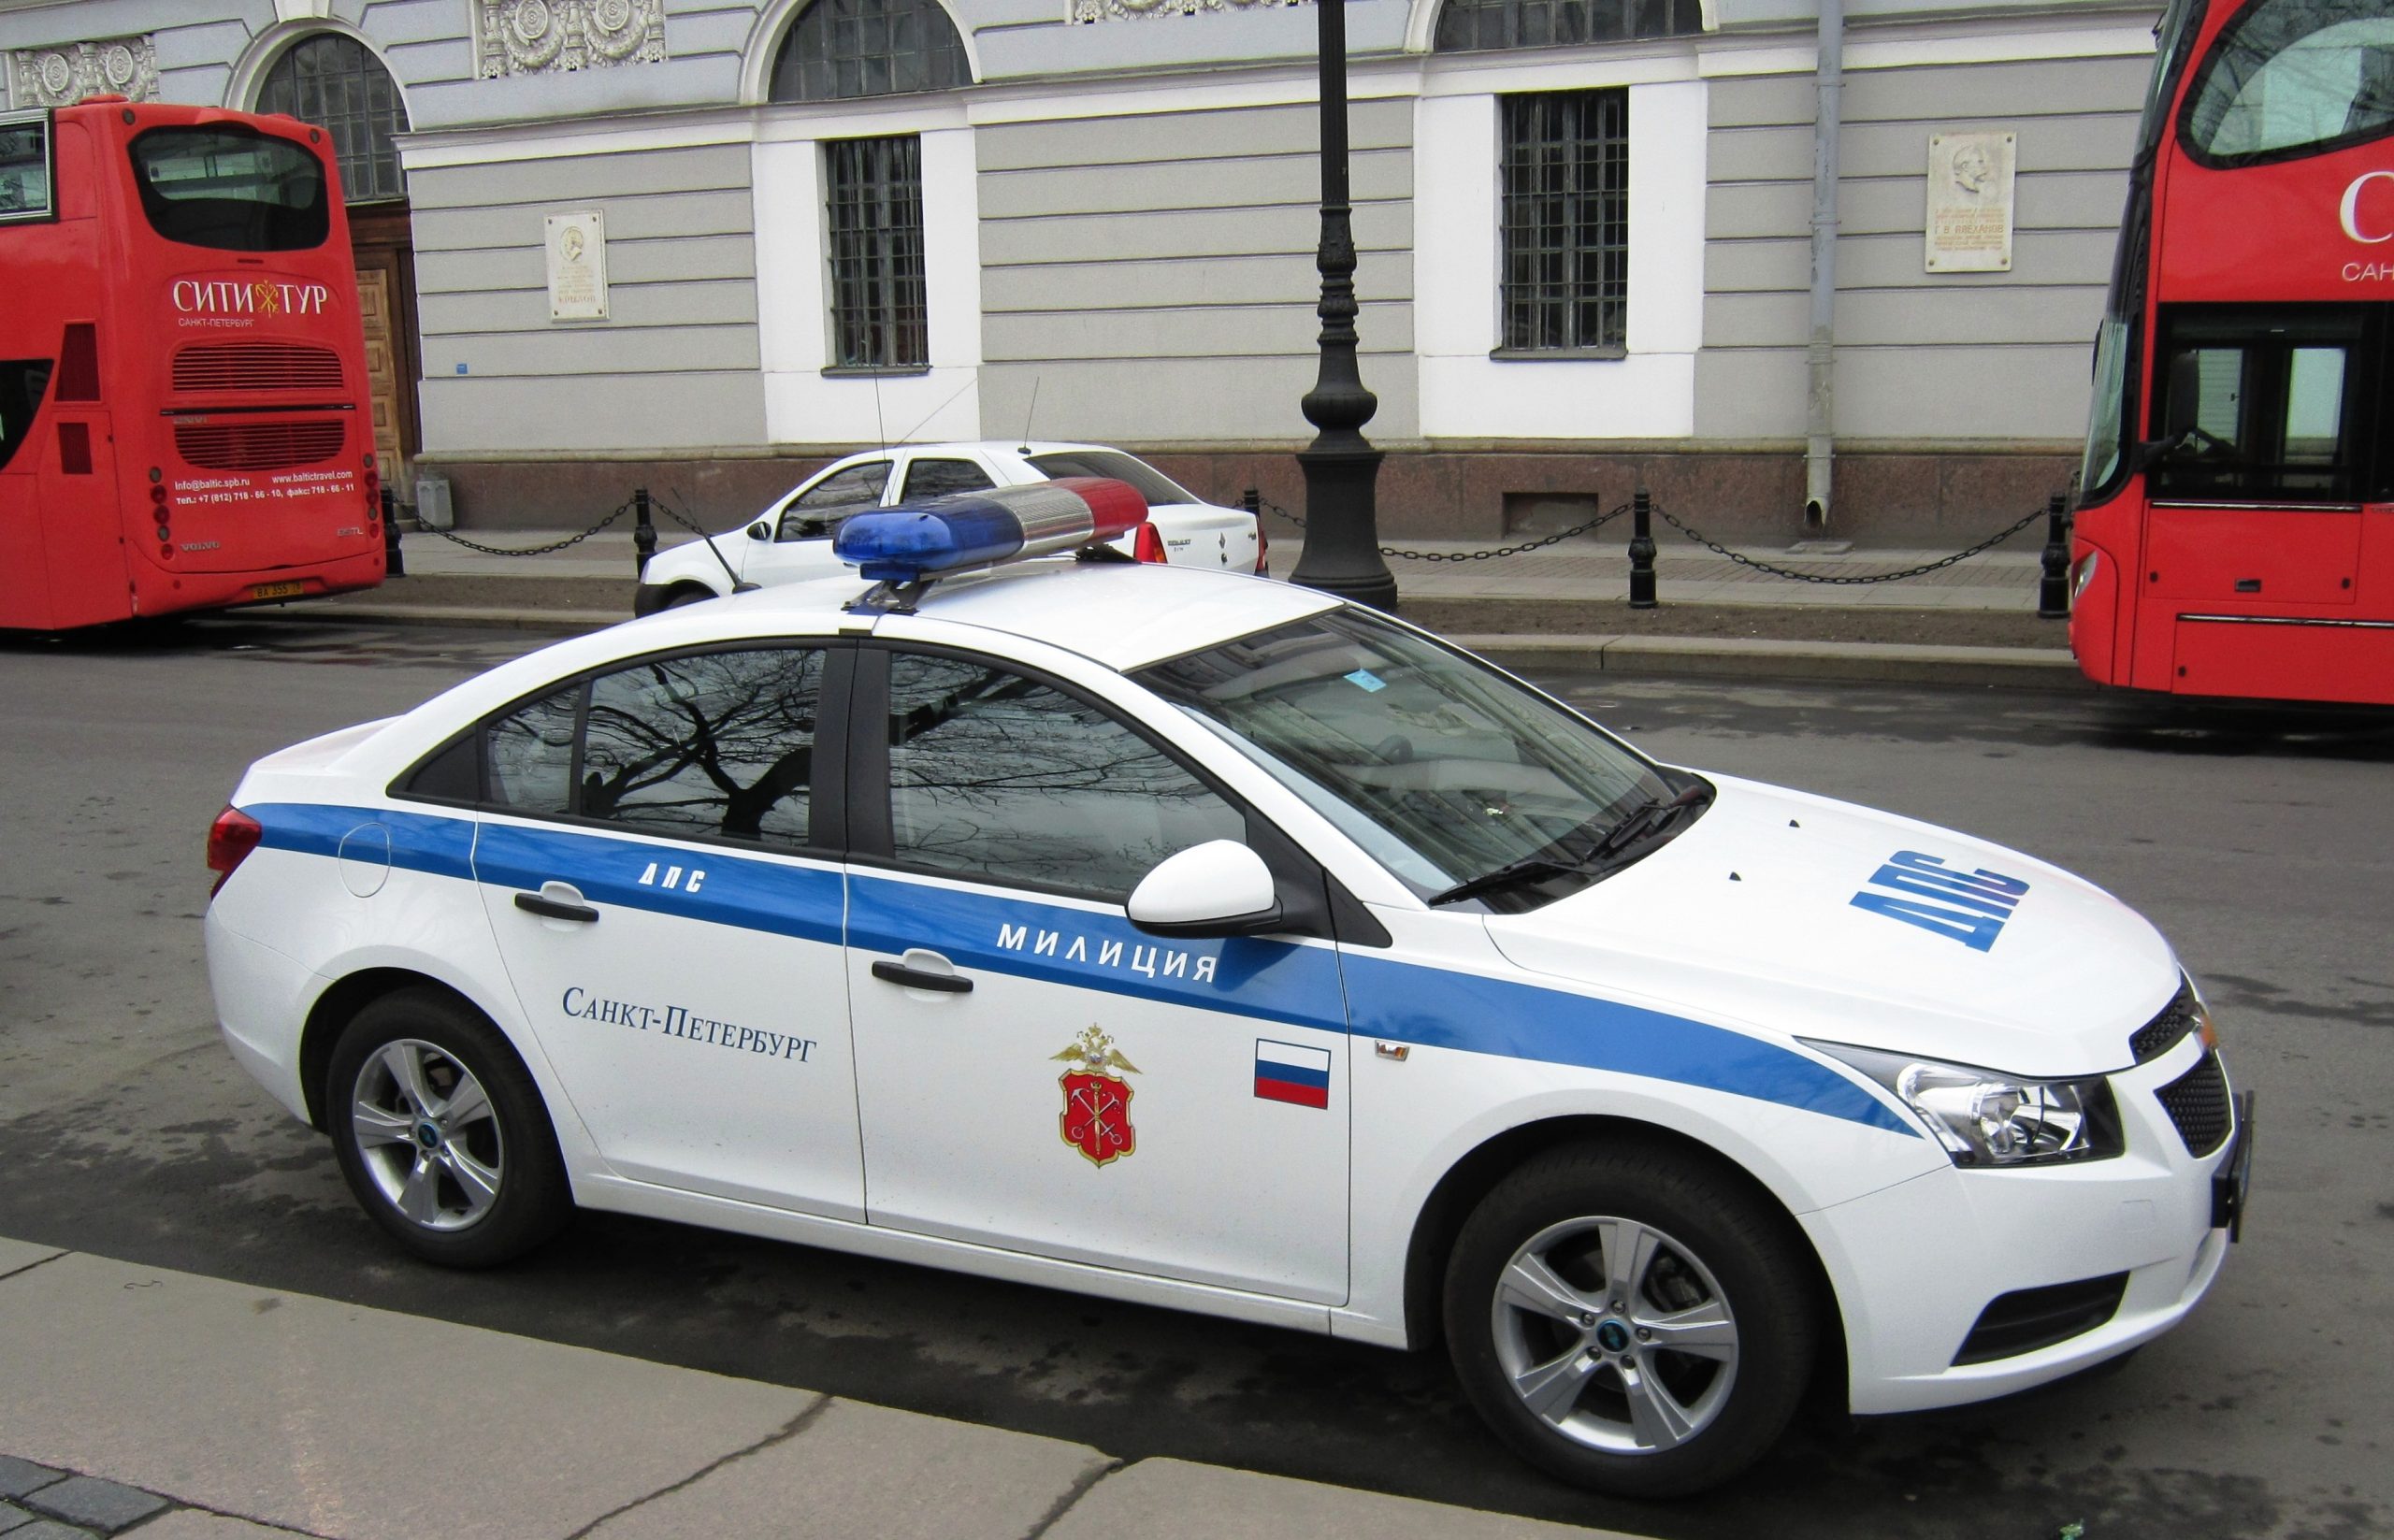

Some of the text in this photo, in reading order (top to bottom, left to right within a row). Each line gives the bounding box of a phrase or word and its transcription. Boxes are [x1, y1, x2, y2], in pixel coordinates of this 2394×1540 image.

[173, 281, 328, 314] СИТИ ТУР
[178, 317, 255, 328] САНКТ-ПЕТЕРБУРГ
[271, 470, 353, 483] www.baltictravel.com
[210, 493, 233, 504] (812)
[179, 541, 222, 553] VOLVO
[638, 862, 706, 893] ДПС
[1848, 850, 2031, 953] ДПС
[996, 923, 1218, 983] МИЛИЦИЯ
